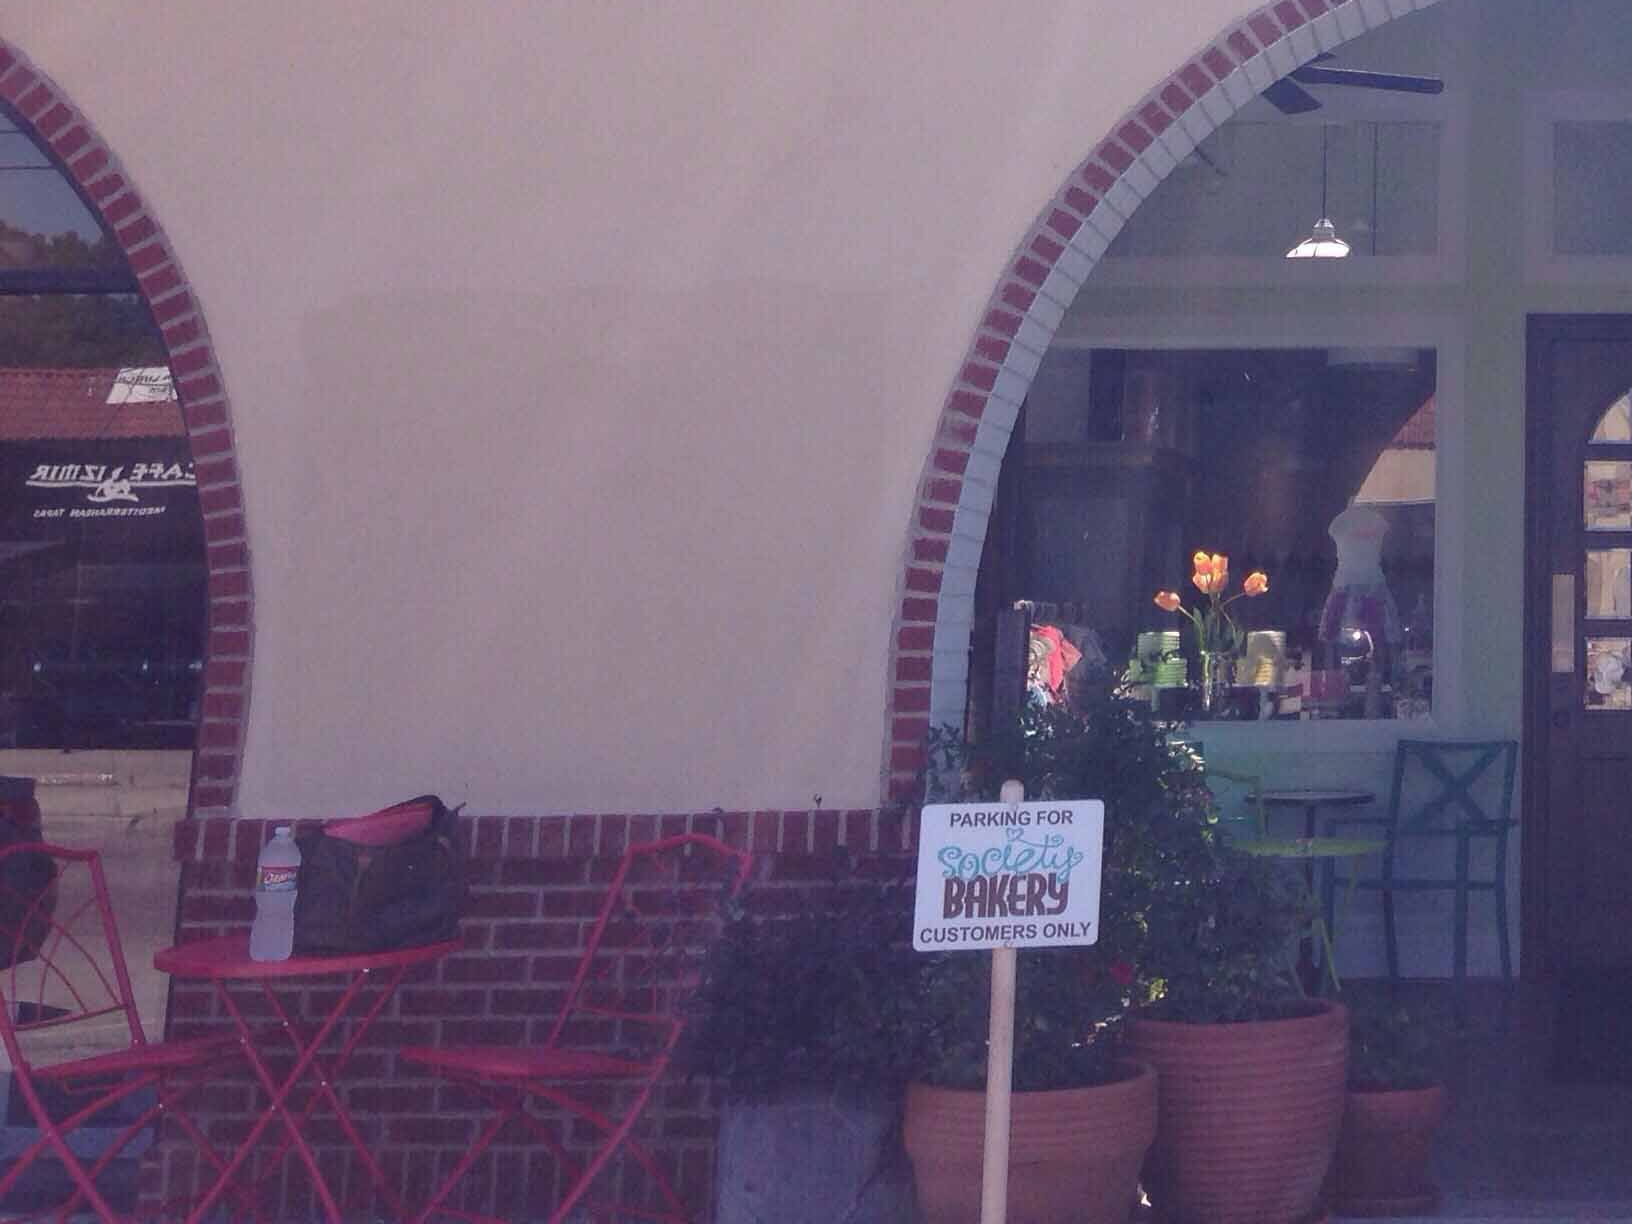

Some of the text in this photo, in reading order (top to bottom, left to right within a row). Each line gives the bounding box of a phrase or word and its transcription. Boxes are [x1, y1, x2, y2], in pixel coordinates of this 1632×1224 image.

[950, 810, 1073, 828] PARKING FOR
[937, 828, 1084, 884] Society
[943, 873, 1069, 919] BAKERY
[920, 922, 1092, 944] CUSTOMERS ONLY
